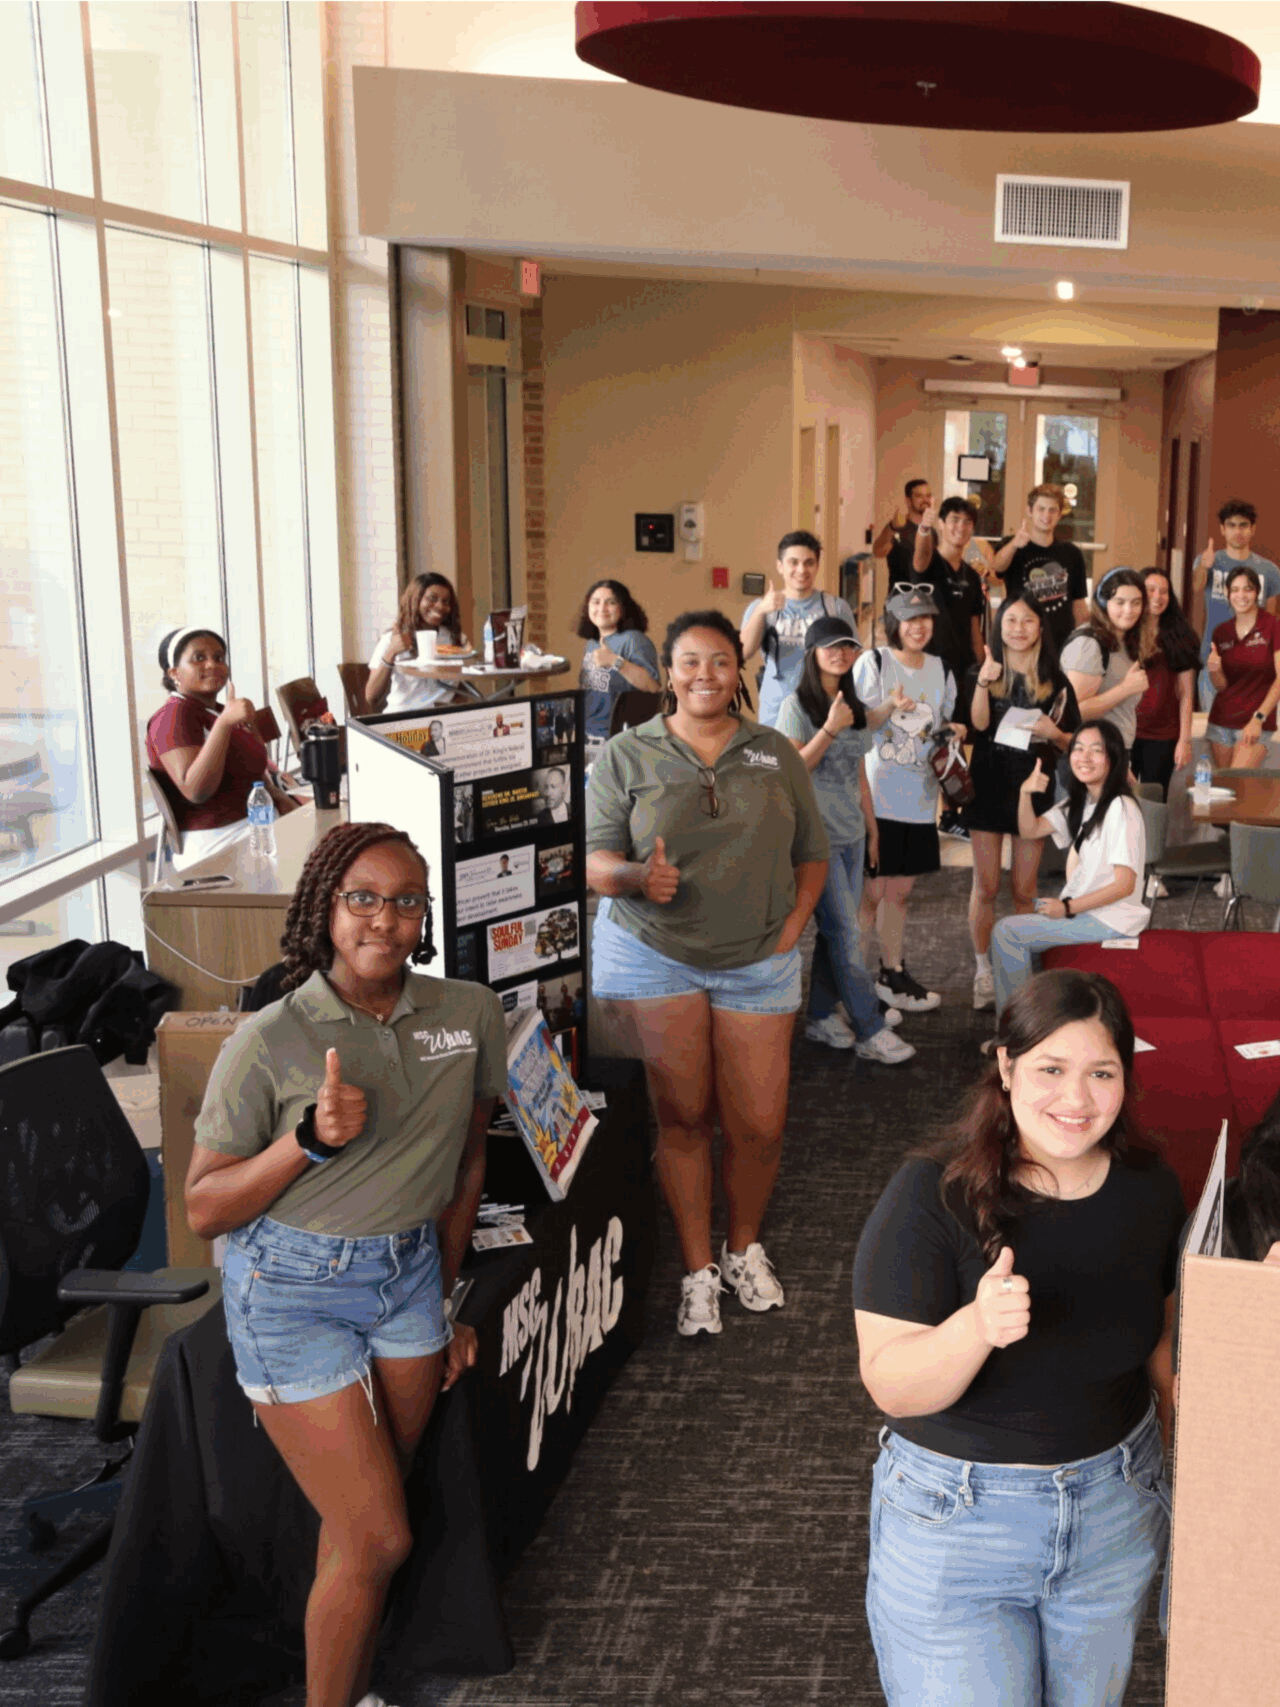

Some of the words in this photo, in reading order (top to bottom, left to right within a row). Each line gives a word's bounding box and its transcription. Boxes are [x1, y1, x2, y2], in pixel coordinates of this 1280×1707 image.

[491, 920, 524, 941] SOULFUL
[494, 933, 524, 952] SUNDAY
[185, 1016, 238, 1028] OPEN
